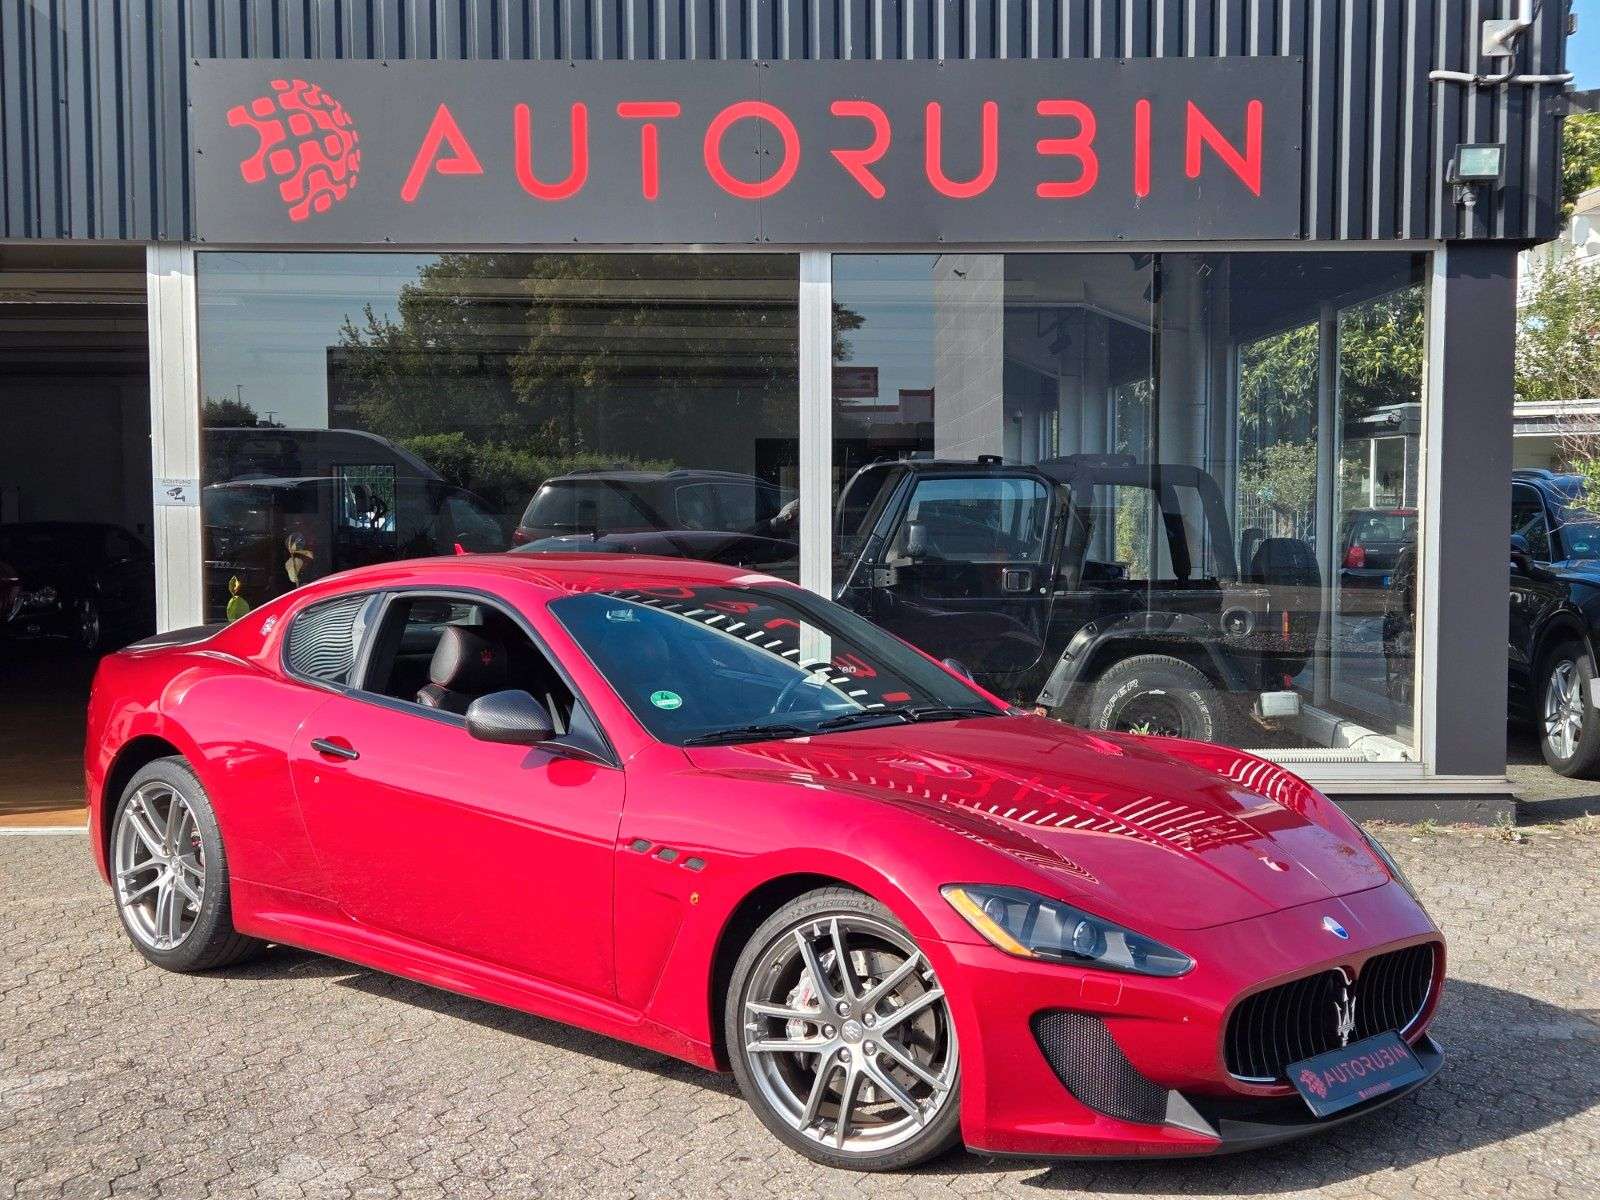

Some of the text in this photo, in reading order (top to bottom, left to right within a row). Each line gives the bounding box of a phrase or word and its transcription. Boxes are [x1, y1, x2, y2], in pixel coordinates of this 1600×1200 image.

[400, 98, 1263, 202] AUTORUBIN
[1100, 678, 1139, 731] OOPER
[1189, 691, 1213, 742] DISCO
[1323, 1044, 1409, 1087] AUTORUBIN
